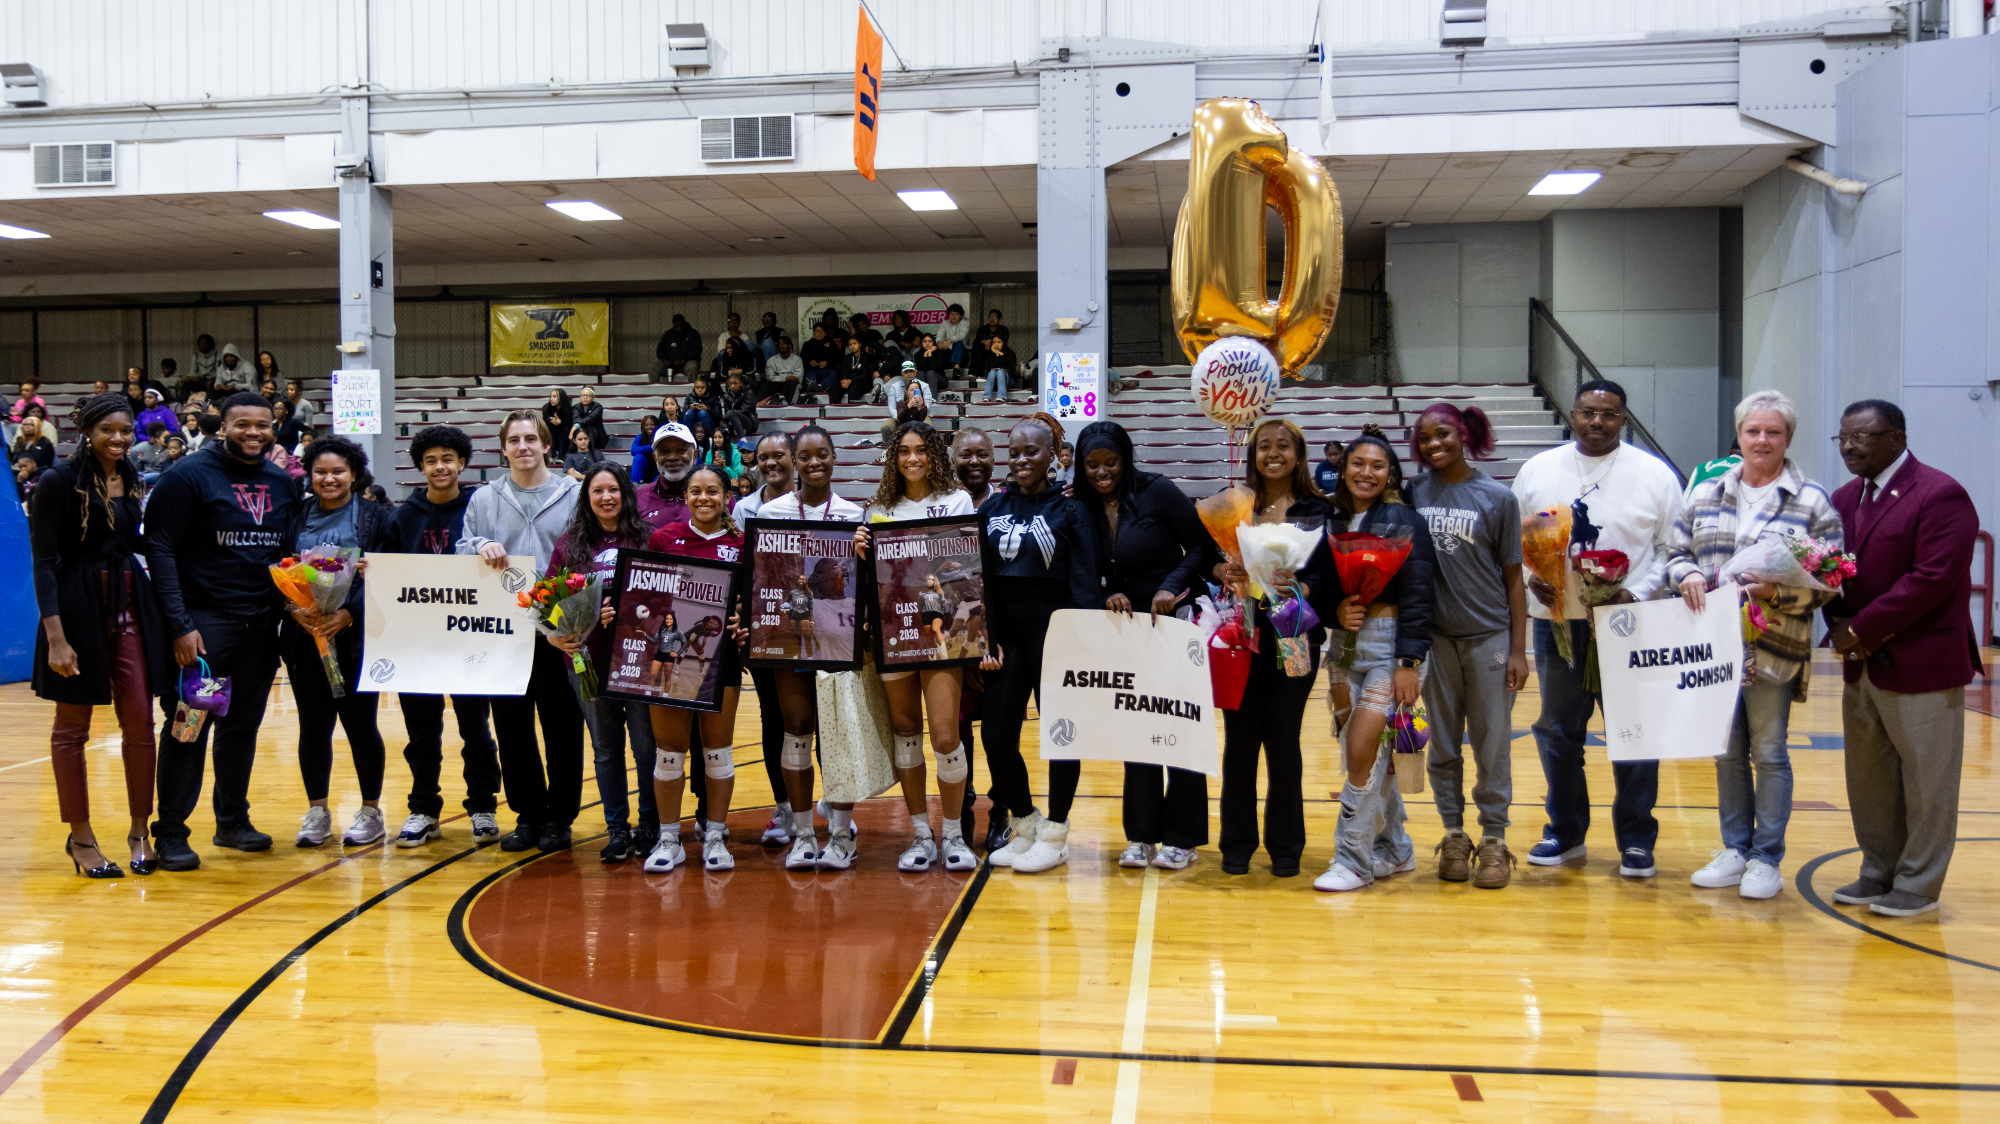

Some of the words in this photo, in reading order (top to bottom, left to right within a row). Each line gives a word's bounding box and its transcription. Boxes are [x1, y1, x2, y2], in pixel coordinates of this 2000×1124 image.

[876, 302, 911, 311] ASHLAND
[529, 341, 560, 351] SMASHED
[561, 341, 575, 350] RVA
[1207, 352, 1261, 380] Proud
[342, 382, 370, 390] SHORT
[1232, 374, 1244, 392] of
[339, 399, 373, 409] COURT
[1073, 392, 1096, 416] #8
[350, 418, 359, 432] 2
[1449, 508, 1478, 520] UNION
[757, 533, 800, 554] ASHLEE
[800, 537, 857, 560] FRANKLIN
[877, 540, 928, 560] AIREANNA
[927, 535, 979, 561] JOHNSON
[626, 568, 682, 593] JASMINE
[678, 579, 724, 604] POWELL
[397, 587, 478, 605] JASMINE
[760, 588, 783, 600] CLASS
[766, 601, 776, 613] OF
[895, 602, 918, 615] CLASS
[447, 615, 514, 635] POWELL
[760, 614, 780, 626] 2026
[903, 616, 912, 627] OF
[899, 628, 919, 641] 2026
[623, 638, 647, 652] CLASS
[463, 652, 488, 666] #2
[627, 652, 638, 664] OF
[1628, 642, 1713, 669] AIREANNA
[620, 664, 641, 678] 2026
[1676, 662, 1733, 690] JOHNSON
[1063, 670, 1135, 690] ASHLEE
[1114, 692, 1201, 722] FRANKLIN
[1150, 734, 1177, 746] #10
